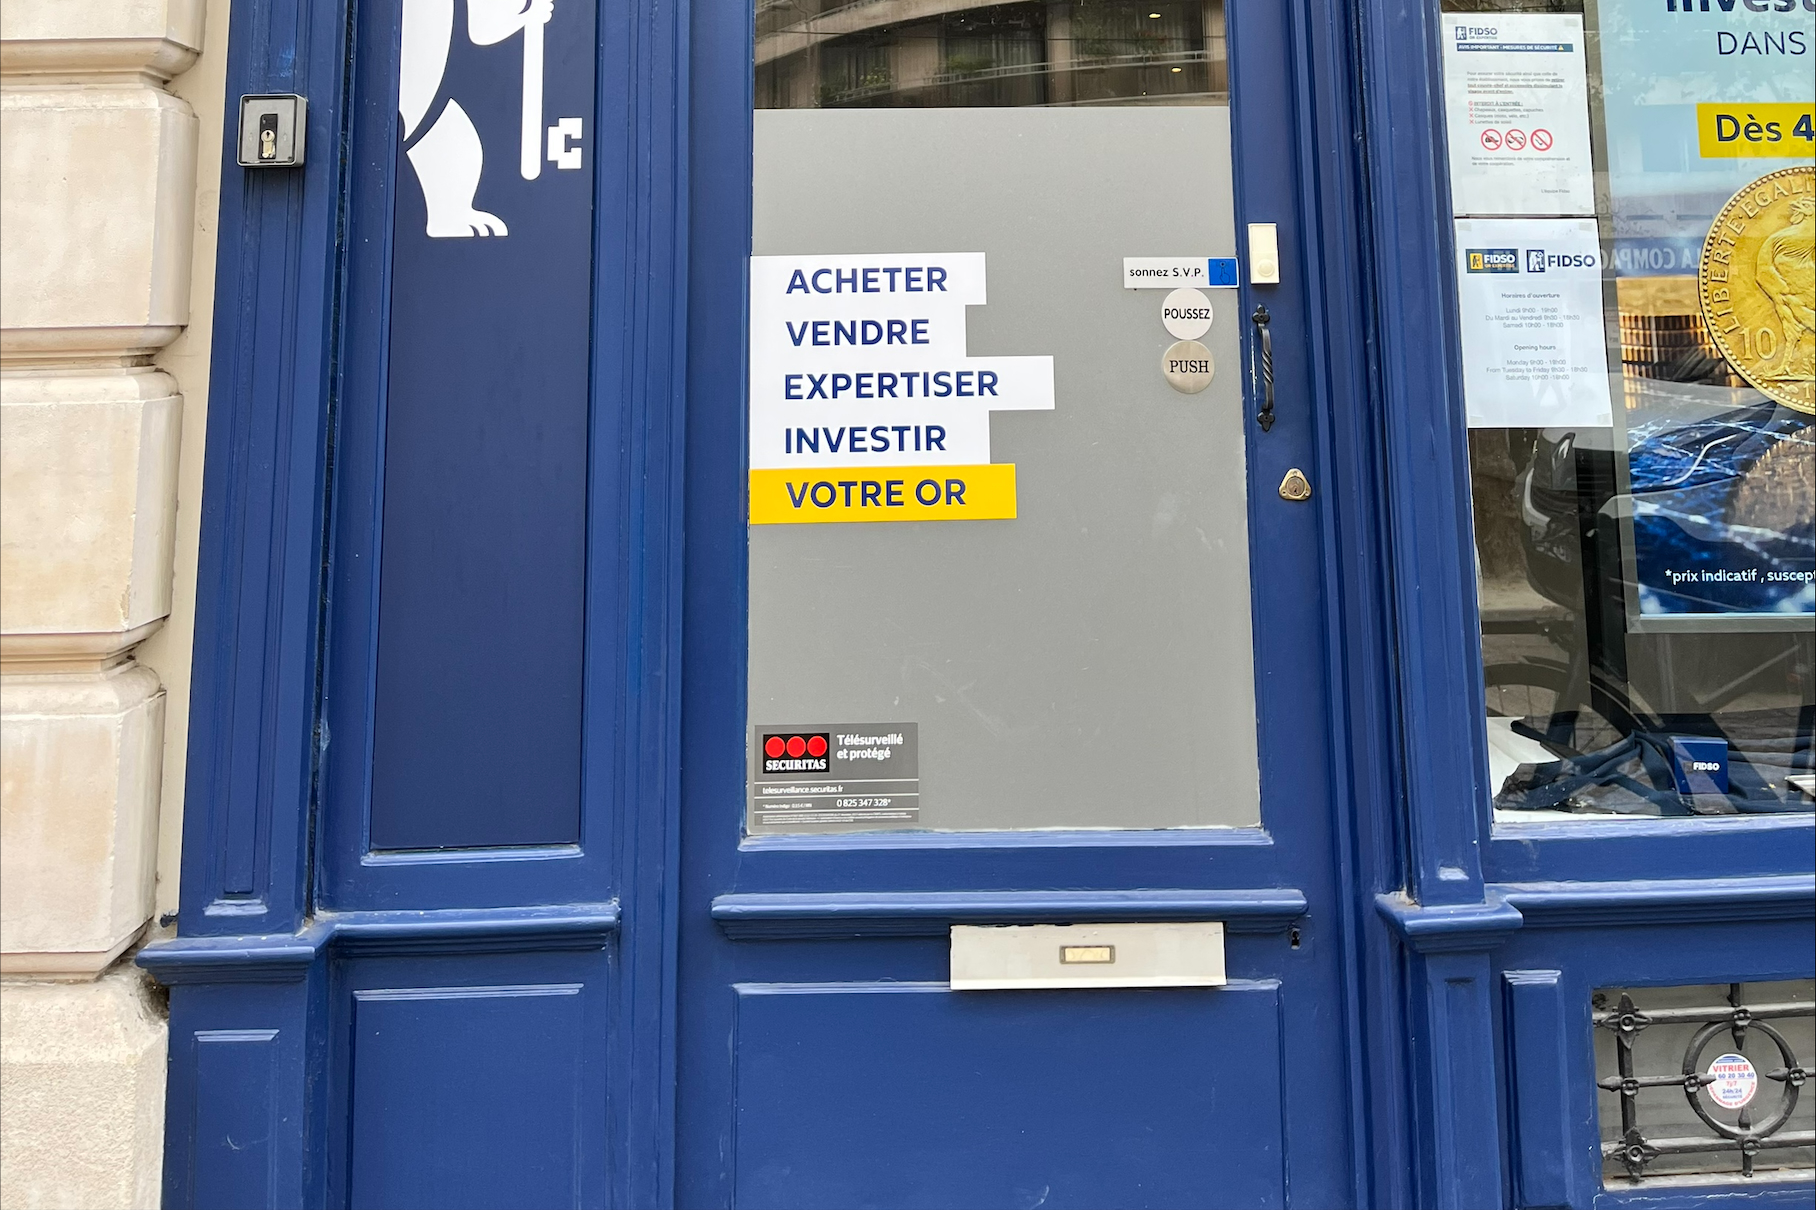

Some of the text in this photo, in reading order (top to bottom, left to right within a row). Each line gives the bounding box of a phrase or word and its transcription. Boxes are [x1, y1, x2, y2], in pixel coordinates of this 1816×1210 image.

[1717, 31, 1807, 55] DANS
[1716, 113, 1782, 142] Dès
[1484, 255, 1515, 263] FIDSO
[1548, 255, 1596, 267] FIDSO
[1129, 267, 1204, 277] sonnez S.V.P.
[786, 266, 948, 294] ACHETER
[1164, 308, 1210, 319] POUSSEZ
[786, 319, 930, 346] VENDRE
[1739, 326, 1776, 361] 10
[1169, 360, 1210, 374] PUSH
[784, 370, 999, 400] EXPERTISER
[785, 425, 946, 454] INVESTIR
[786, 478, 966, 508] VOTRE OR
[1701, 568, 1757, 582] indicatif
[836, 733, 903, 745] Télésurveillé
[837, 748, 891, 760] et protégé
[766, 759, 826, 771] SECURITAS
[1693, 762, 1720, 771] FIDSO
[1713, 1064, 1749, 1072] VITRIER
